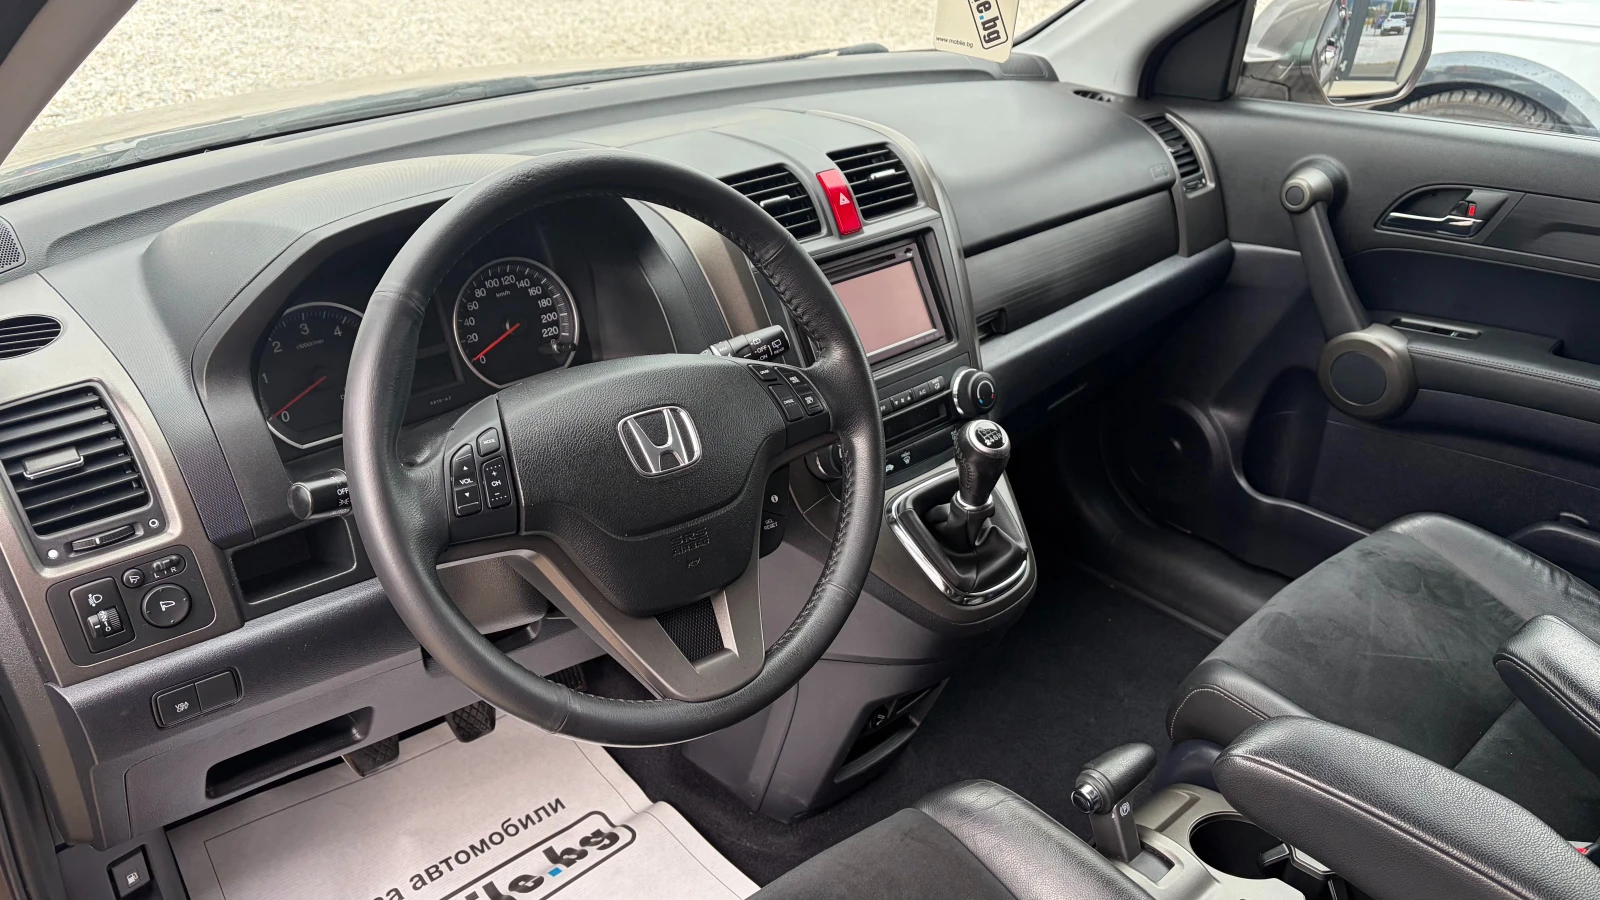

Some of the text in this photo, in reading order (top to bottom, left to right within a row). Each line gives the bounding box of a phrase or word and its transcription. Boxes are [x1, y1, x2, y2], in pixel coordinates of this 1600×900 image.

[974, 0, 1002, 44] e.bg
[935, 35, 974, 49] www.mobile.bg
[484, 278, 500, 289] 100
[500, 274, 516, 286] 120
[515, 278, 531, 289] 140
[474, 287, 487, 298] 80
[528, 286, 542, 296] 160
[466, 300, 479, 311] 60
[537, 297, 552, 308] 180
[463, 316, 475, 327] 40
[540, 311, 558, 323] 200
[299, 323, 310, 335] 3
[333, 325, 343, 337] 4
[541, 326, 559, 338] 220
[466, 332, 478, 343] 20
[271, 340, 283, 353] 2
[757, 345, 767, 353] OFF
[480, 355, 486, 364] 0
[261, 372, 269, 384] 1
[918, 388, 927, 396] A/C
[281, 410, 290, 422] 0
[491, 479, 502, 487] CH
[336, 487, 349, 496] OFF
[670, 527, 708, 547] SRS
[409, 797, 567, 891] автомобили
[464, 828, 620, 900] le.bg
